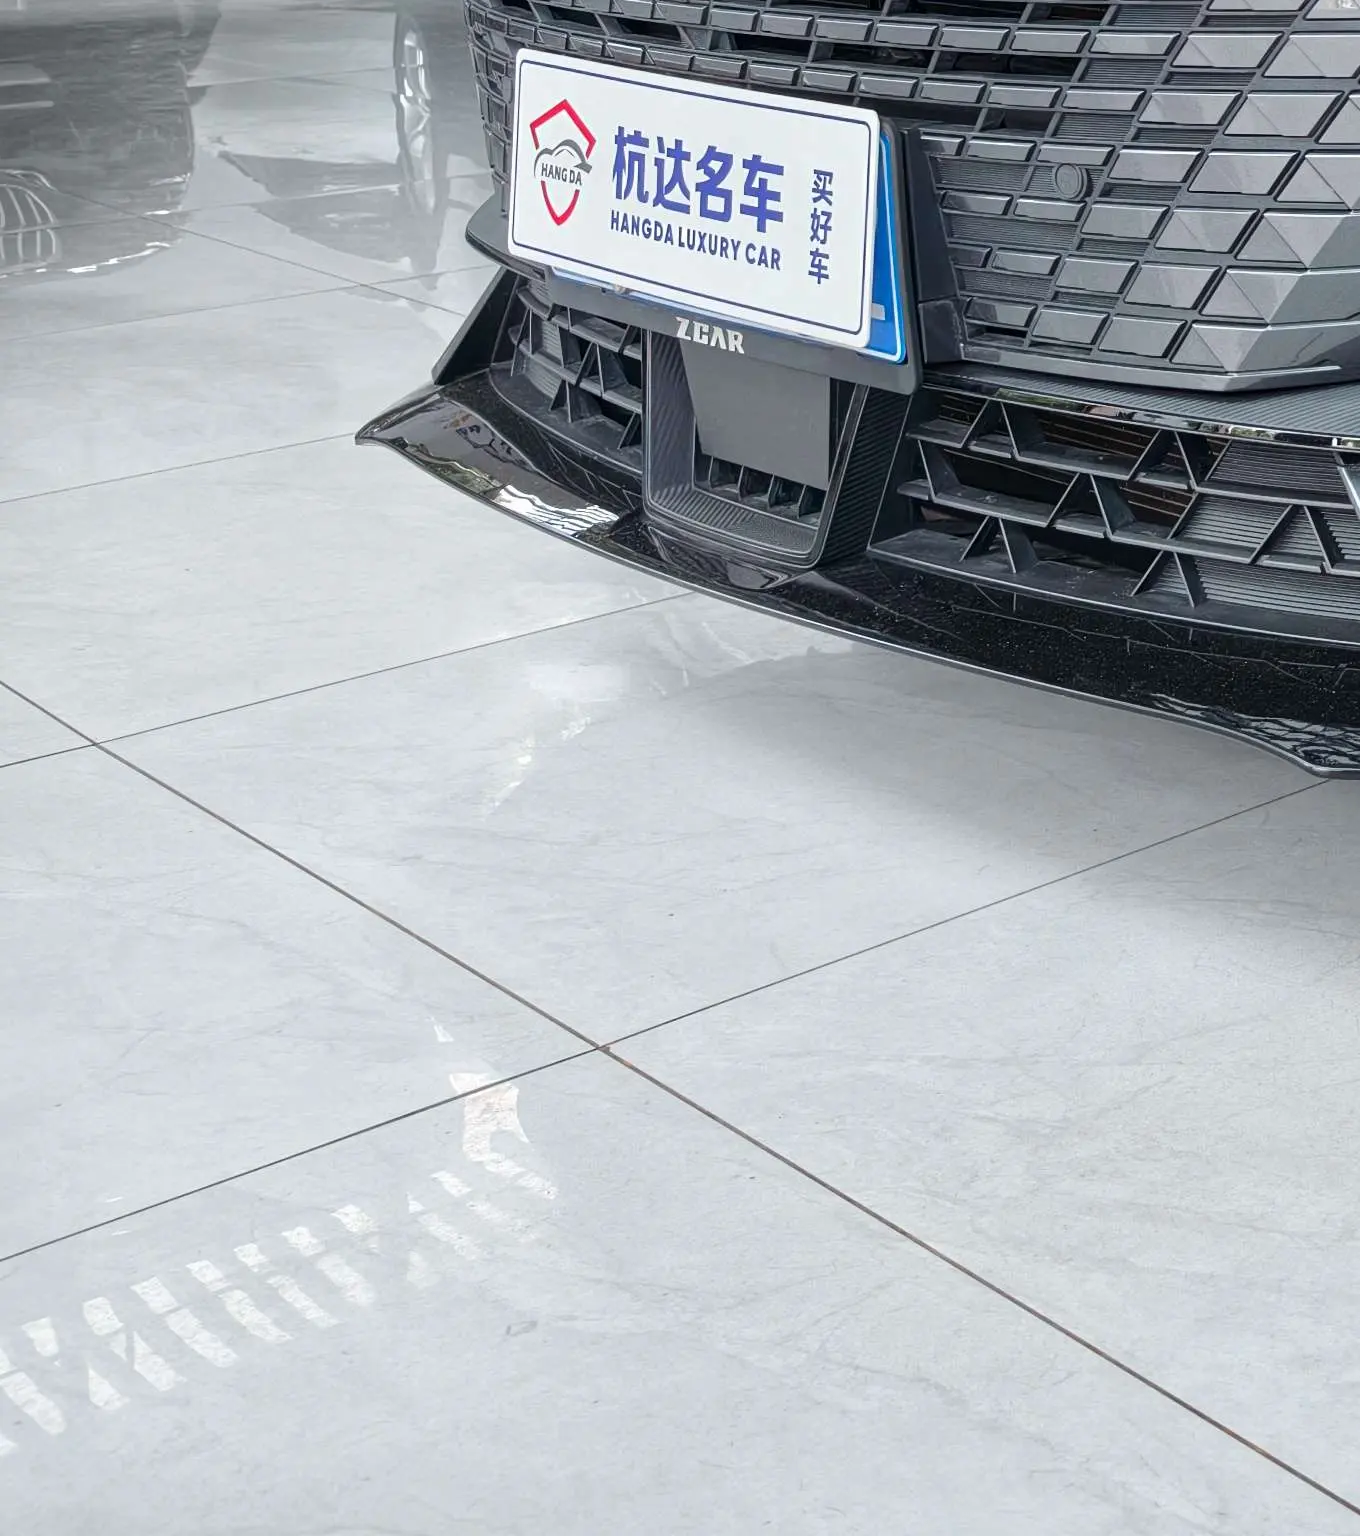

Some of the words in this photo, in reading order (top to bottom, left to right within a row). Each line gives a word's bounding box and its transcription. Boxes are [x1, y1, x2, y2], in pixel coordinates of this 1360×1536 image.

[541, 162, 567, 182] HANG
[569, 170, 582, 186] DA
[612, 125, 785, 233] 杭达名车
[610, 209, 674, 246] HANGDA
[678, 226, 741, 261] LUXURY
[745, 242, 781, 271] CAR
[808, 168, 834, 285] 买好车
